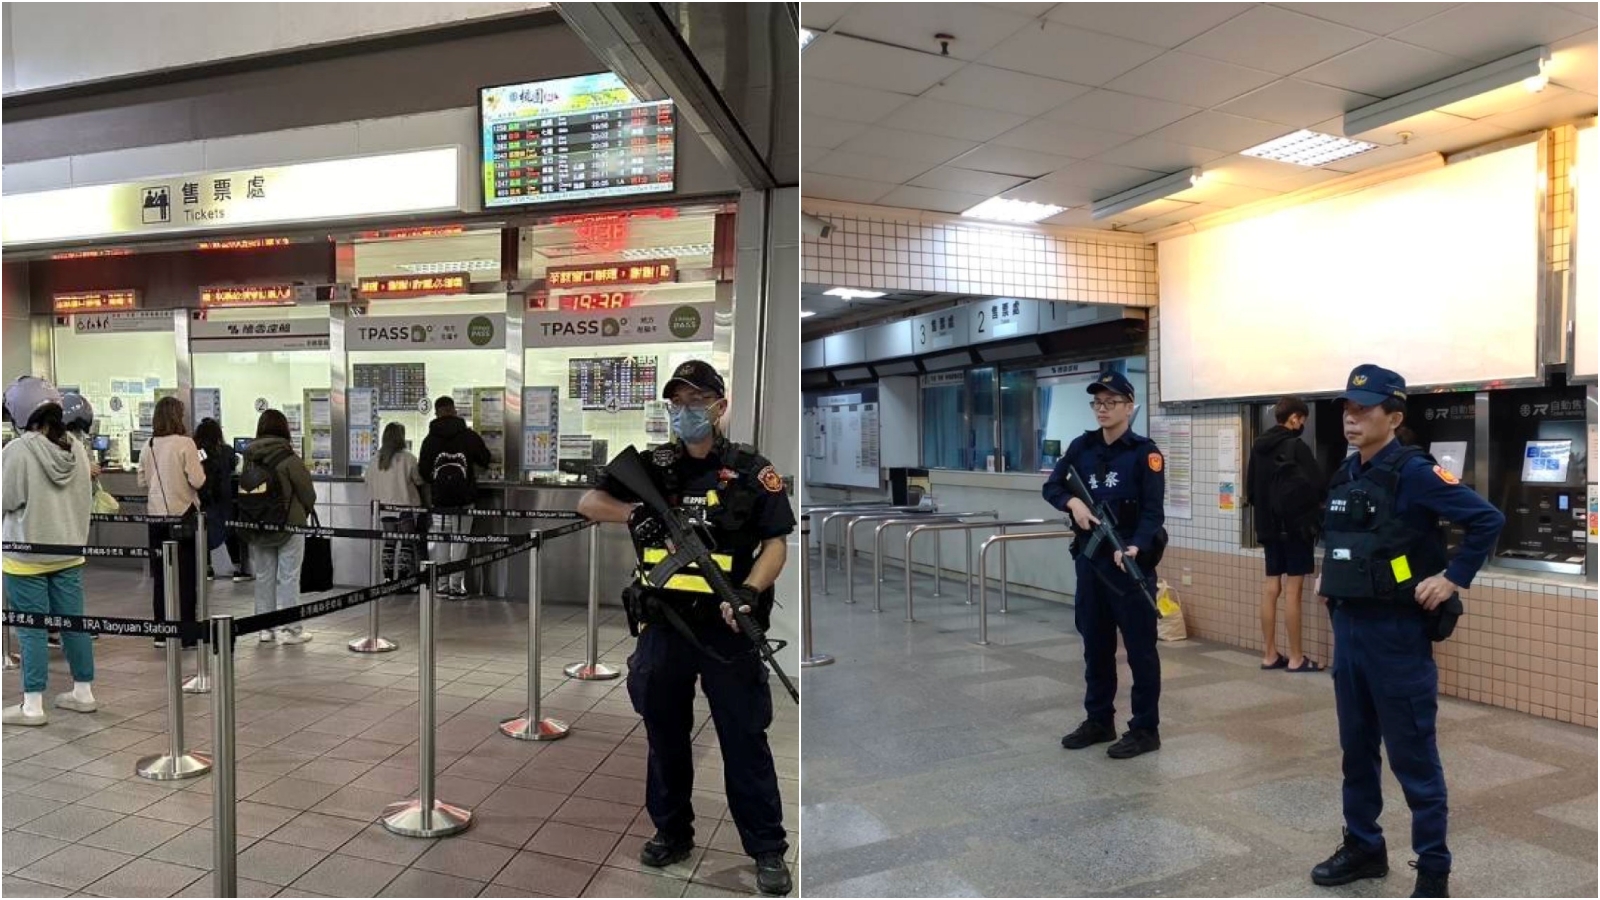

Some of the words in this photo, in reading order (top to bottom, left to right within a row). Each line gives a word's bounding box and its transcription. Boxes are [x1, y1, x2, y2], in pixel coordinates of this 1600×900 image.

[181, 176, 265, 205] 售票處
[183, 210, 225, 222] Tickets
[573, 293, 624, 311] 19:38
[991, 301, 1020, 319] 售票處
[540, 320, 598, 336] TPASS
[931, 315, 955, 332] 售票處
[977, 311, 985, 333] 2
[358, 327, 409, 340] TPASS
[920, 324, 926, 345] 3
[1088, 471, 1121, 489] 警察
[12, 542, 32, 551] Station
[462, 535, 486, 544] Taoyuan
[487, 535, 510, 543] Station
[44, 617, 72, 628] 桃園站
[82, 618, 100, 630] TRA
[103, 620, 142, 634] Taoyuan
[143, 622, 178, 635] Station
